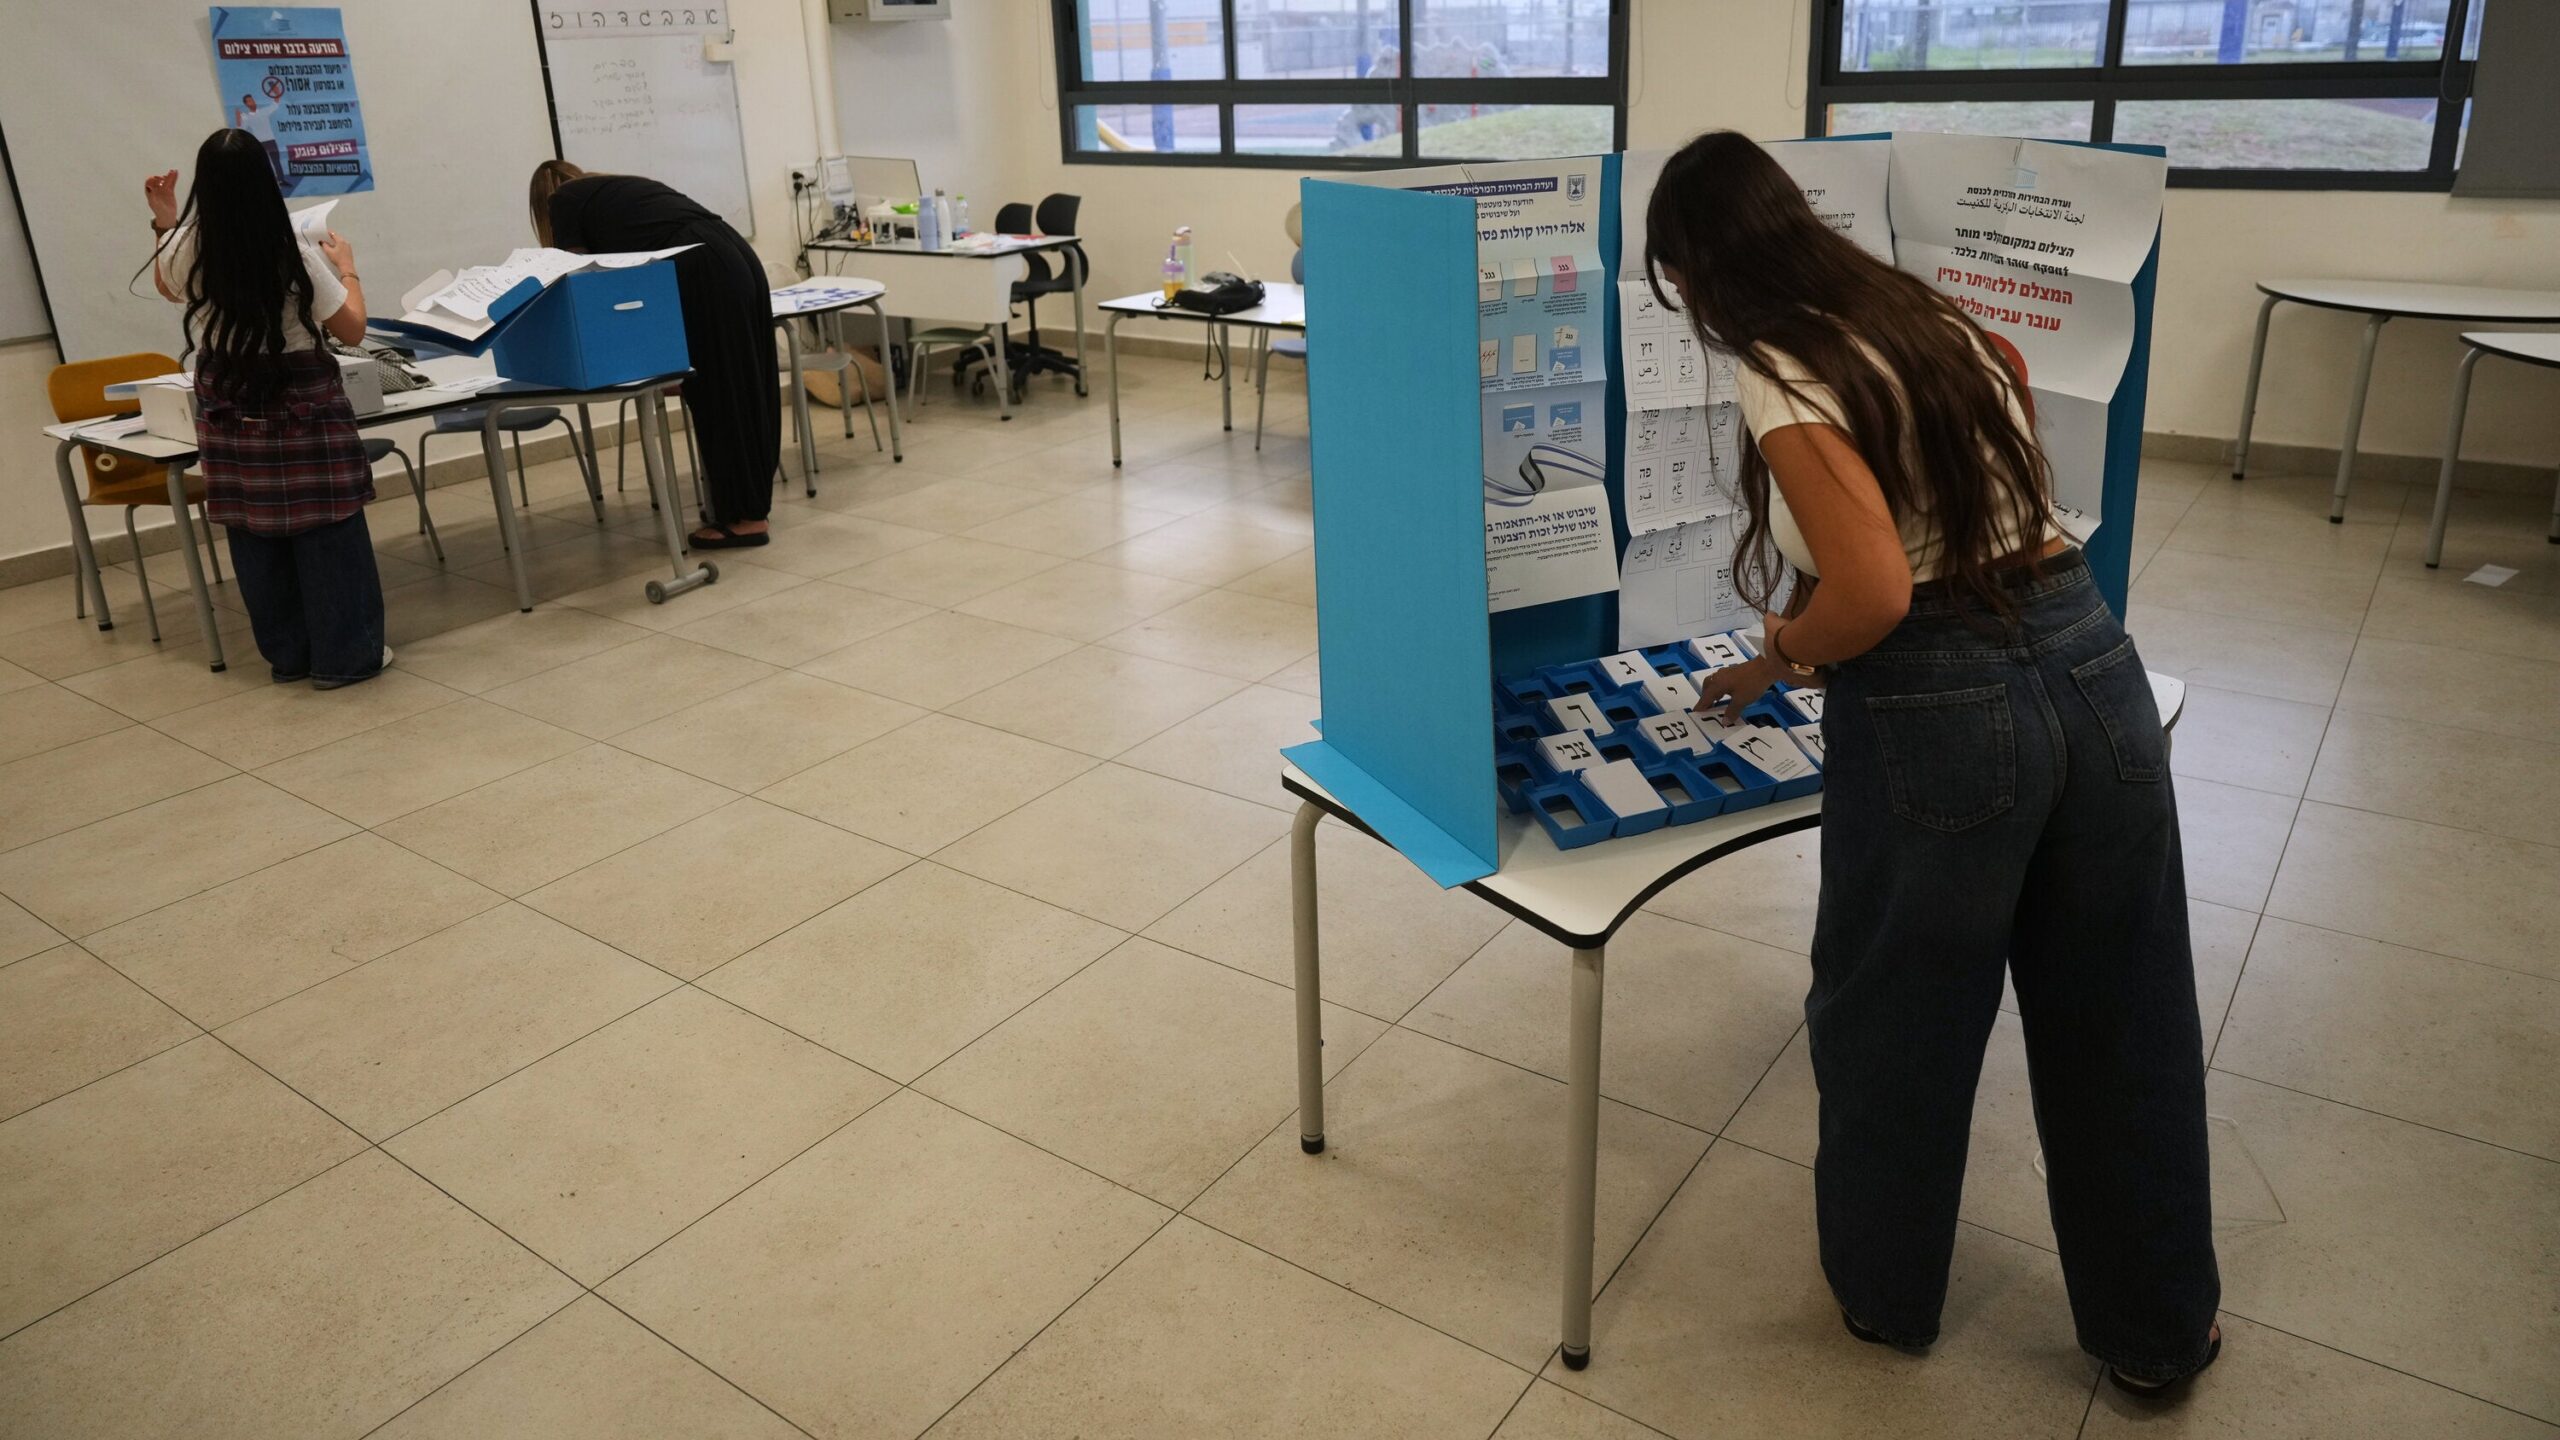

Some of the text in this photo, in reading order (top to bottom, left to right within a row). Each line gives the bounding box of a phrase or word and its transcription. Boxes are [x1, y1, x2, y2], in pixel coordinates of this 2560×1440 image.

[224, 43, 338, 54] הודעה בדבר איסור צילום
[294, 143, 352, 158] הצילום פוגע
[1463, 185, 1496, 194] המרכזית
[1498, 183, 1532, 191] הבחירות
[1536, 181, 1553, 190] ועדת
[1967, 187, 1992, 197] לכנסת
[1503, 199, 1511, 207] על
[1957, 198, 1991, 209] للكنيست
[2017, 193, 2050, 205] הבחירות
[2051, 197, 2071, 208] ועדת
[1481, 211, 1507, 219] שיבושים
[2019, 206, 2062, 220] الانتخابات
[2064, 209, 2085, 225] لجنة
[1501, 226, 1533, 241] קולות
[1536, 224, 1558, 237] יהיו
[1561, 220, 1585, 234] אלה
[1955, 227, 1981, 239] מותר
[2002, 235, 2035, 250] במקום
[2038, 242, 2075, 257] הצילום
[1951, 245, 1977, 259] בלבד.
[1937, 266, 1962, 283] כדין
[2019, 281, 2073, 305] המצלם
[2026, 311, 2062, 331] עובר
[1639, 467, 1652, 480] פה
[1672, 461, 1686, 473] עם
[1553, 511, 1564, 521] או
[1567, 505, 1596, 519] שיבוש
[1495, 514, 1550, 530] אי-התאמה
[1493, 519, 1599, 545] אינו שולל זכות הצבעה
[1705, 643, 1734, 659] בי
[1619, 660, 1637, 674] ג
[1666, 686, 1678, 695] י
[1655, 721, 1689, 742] עם
[1555, 741, 1592, 761] צבי
[1739, 737, 1773, 762] רץ
